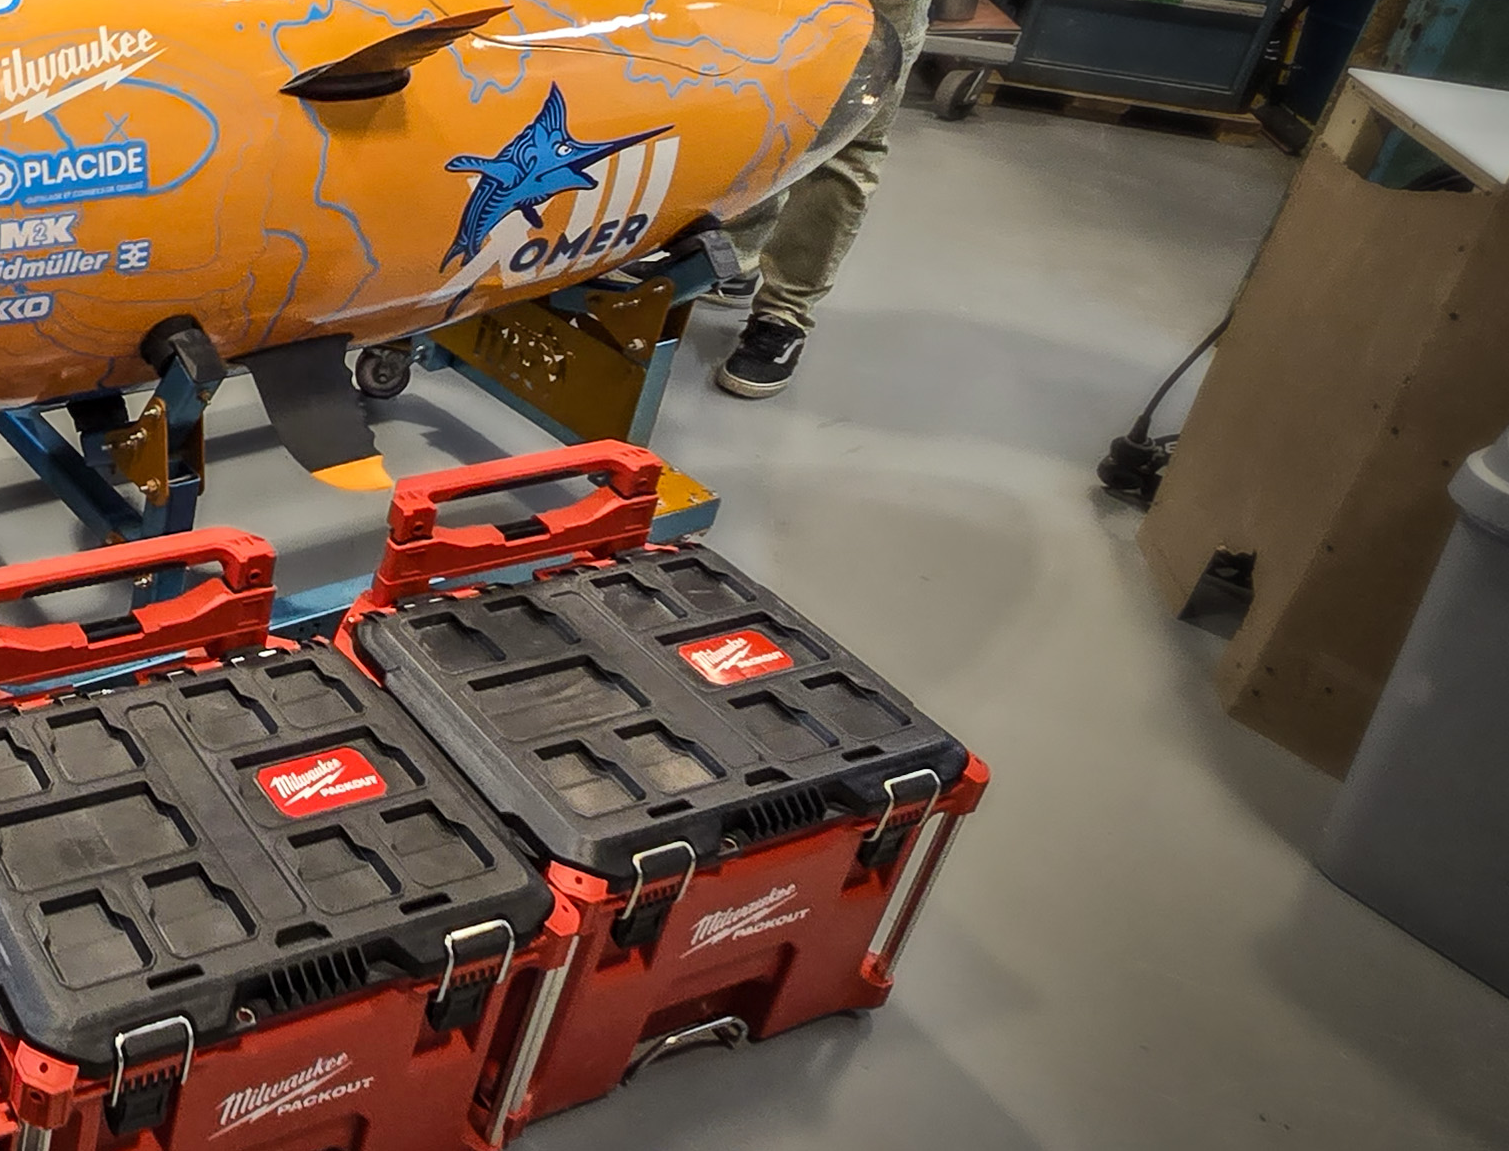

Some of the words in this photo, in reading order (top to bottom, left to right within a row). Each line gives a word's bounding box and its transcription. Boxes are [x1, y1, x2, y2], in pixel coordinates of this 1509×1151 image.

[23, 147, 144, 188] PLACIDE
[509, 213, 649, 273] OMER
[269, 758, 343, 799] Milwaukee
[319, 774, 379, 798] PACKOUT
[690, 883, 797, 946] Milwaukee
[731, 907, 811, 941] PACKOUT
[215, 1051, 349, 1126] Milwaukee
[277, 1076, 375, 1117] PACKOUT
